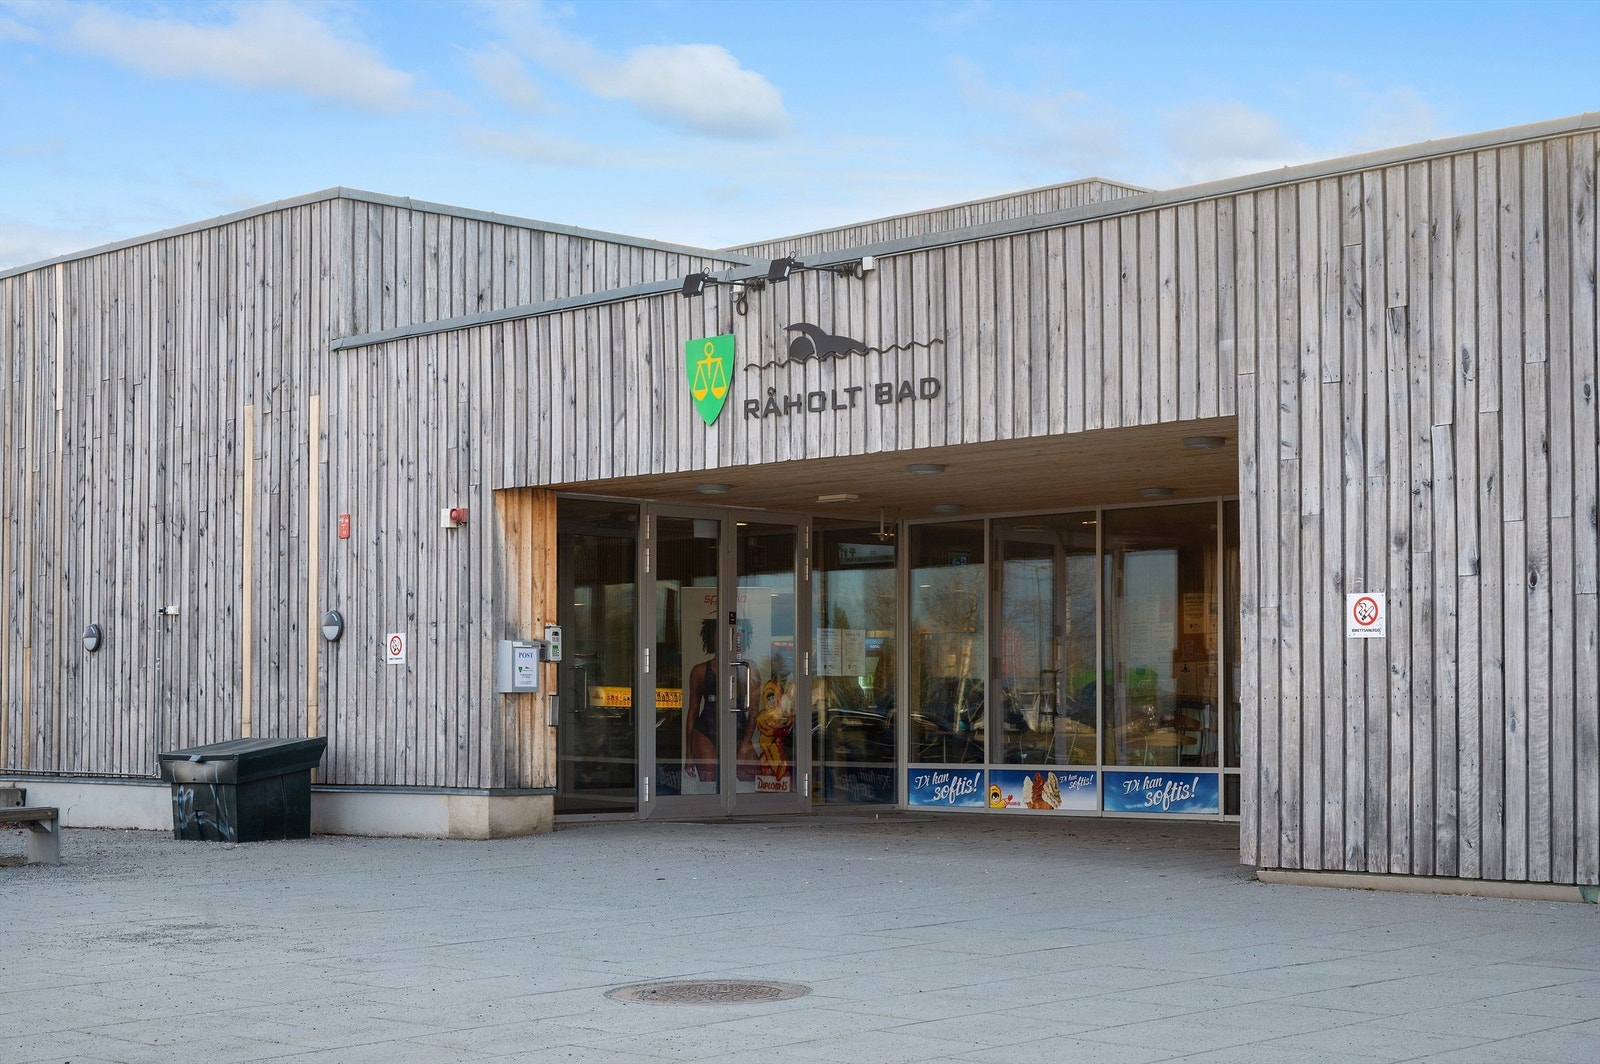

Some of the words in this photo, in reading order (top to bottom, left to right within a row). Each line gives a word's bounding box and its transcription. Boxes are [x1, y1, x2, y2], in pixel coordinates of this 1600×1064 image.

[743, 386, 862, 420] RÅHOLT
[875, 377, 941, 405] BAD
[914, 775, 930, 789] Vi
[932, 772, 949, 785] kan
[933, 772, 981, 804] softis!
[1069, 774, 1094, 791] softis!
[1122, 779, 1140, 795] Vi
[1143, 775, 1163, 790] kan
[1144, 776, 1199, 811] softis!
